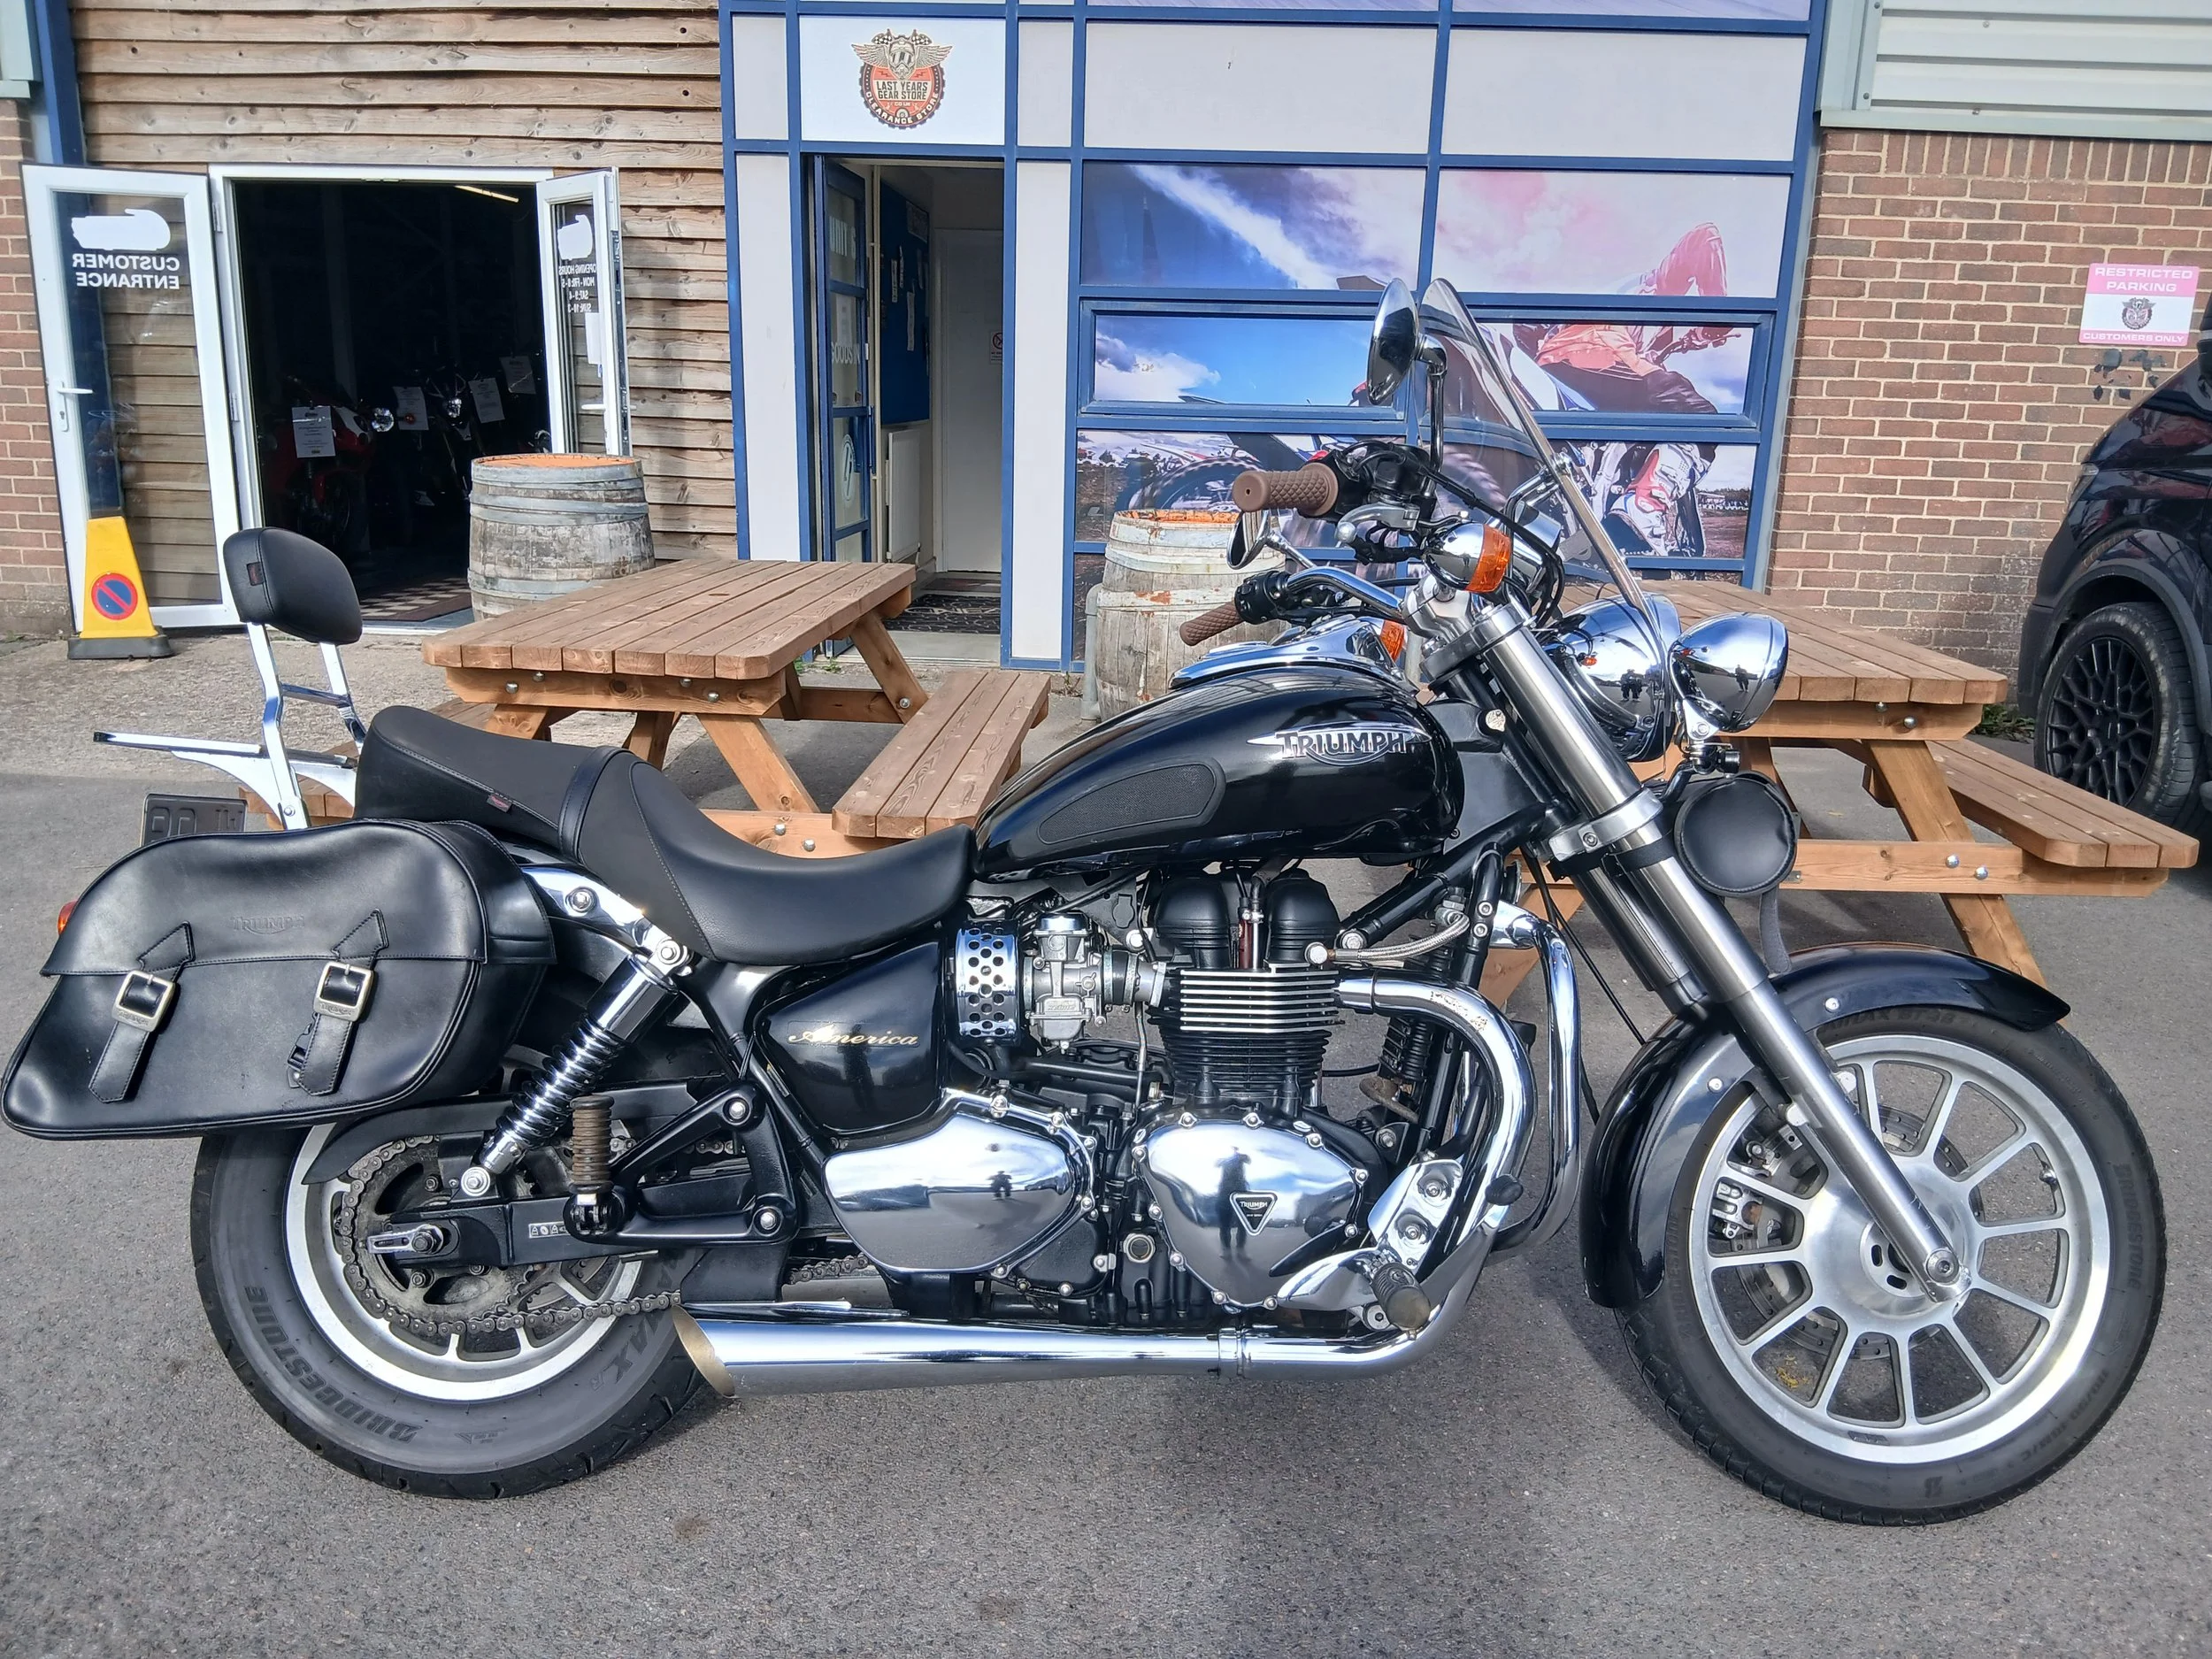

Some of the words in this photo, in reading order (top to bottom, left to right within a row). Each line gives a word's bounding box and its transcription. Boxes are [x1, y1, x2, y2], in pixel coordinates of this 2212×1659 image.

[876, 81, 898, 91] LAST
[900, 81, 928, 91] YEARS
[878, 90, 899, 100] GEAR
[901, 90, 926, 100] STORE
[866, 91, 913, 124] CLEARANCE
[916, 93, 939, 120] STORE
[2094, 266, 2193, 280] RESTRICTED
[2106, 280, 2177, 292] PARKING
[2082, 332, 2154, 342] CUSTOMERS
[2154, 333, 2185, 343] ONLY
[1275, 731, 1408, 761] TRIUMPH
[788, 1024, 919, 1045] America
[1239, 1201, 1268, 1210] TRIUMPH
[243, 1286, 424, 1444] BRIDGESTONE
